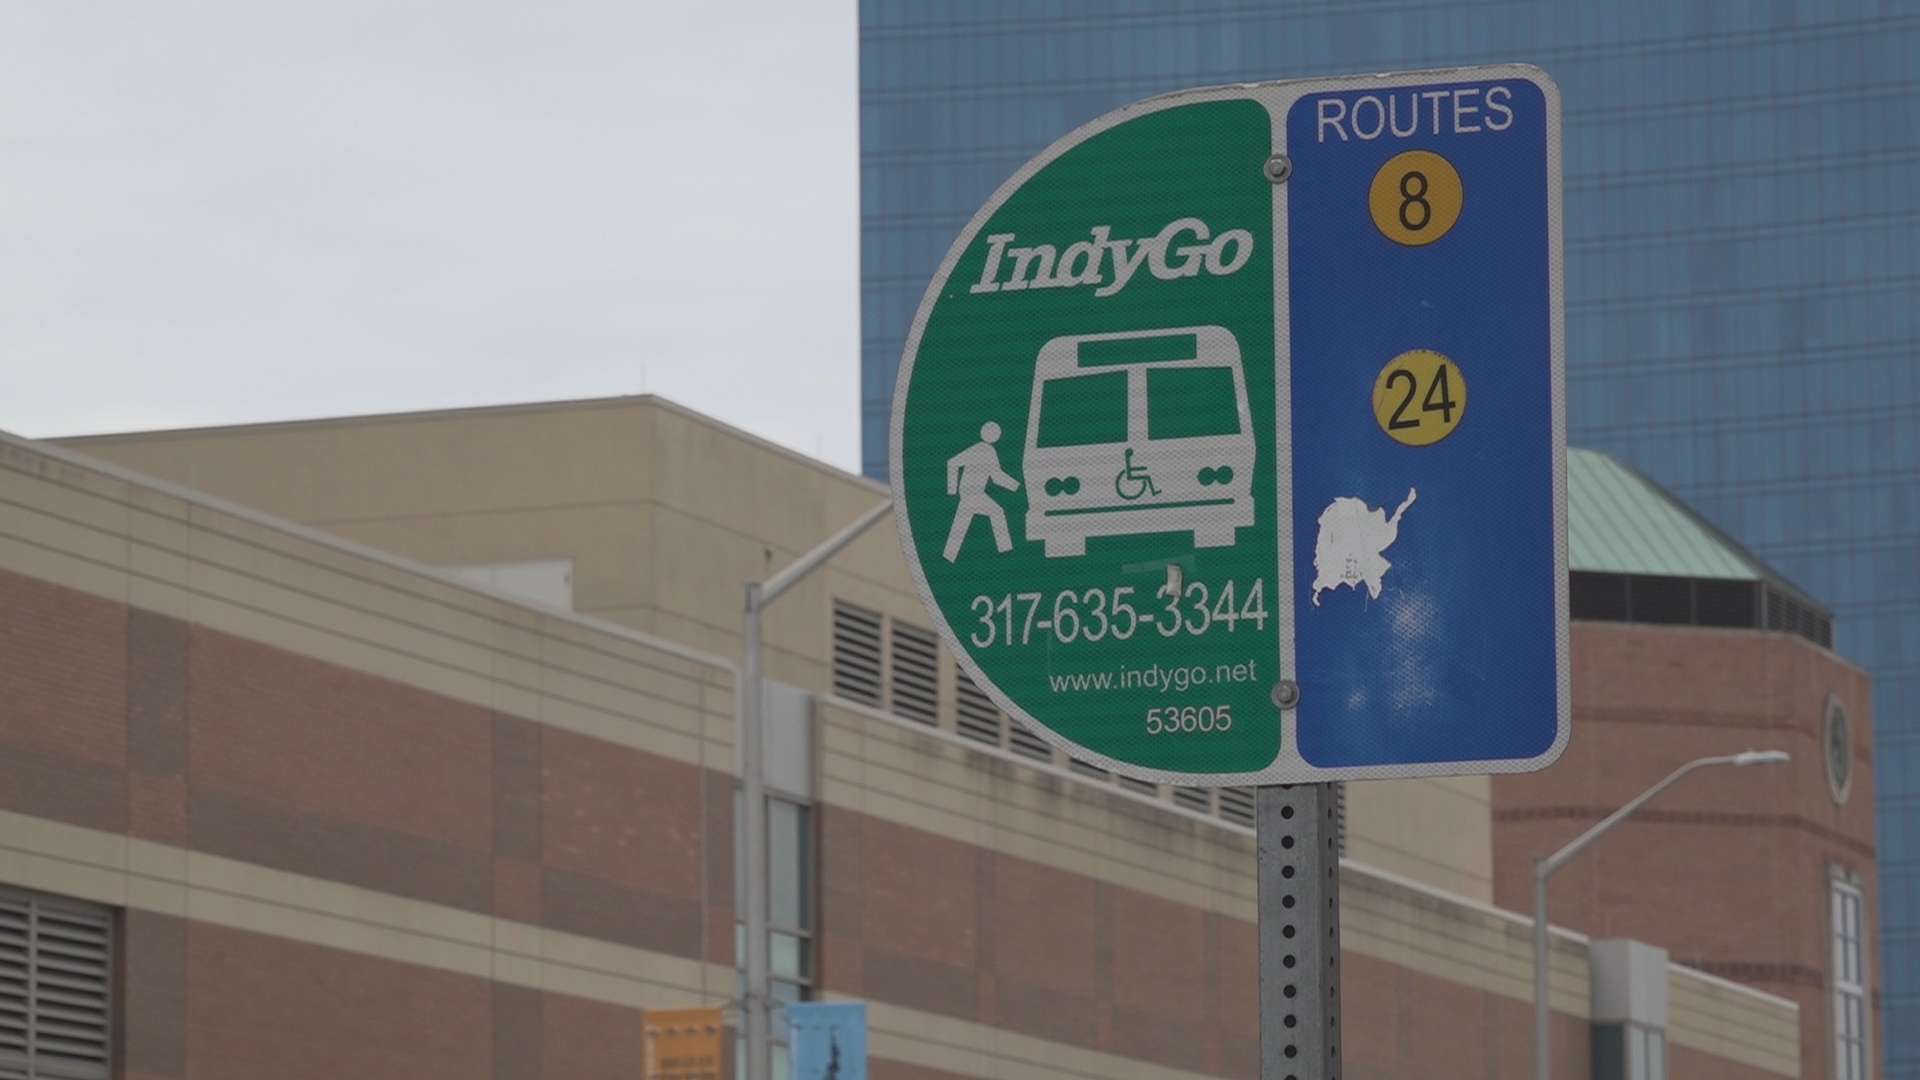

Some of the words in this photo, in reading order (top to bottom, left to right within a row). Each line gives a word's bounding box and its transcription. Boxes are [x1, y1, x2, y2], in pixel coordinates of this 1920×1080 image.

[1317, 86, 1514, 142] ROUTES
[1399, 171, 1431, 231] 8
[969, 217, 1254, 297] IndyGo
[1386, 363, 1456, 431] 24
[970, 577, 1269, 649] 317-635-3344
[1048, 659, 1258, 693] www.indygo.net
[1146, 705, 1233, 735] 53605
